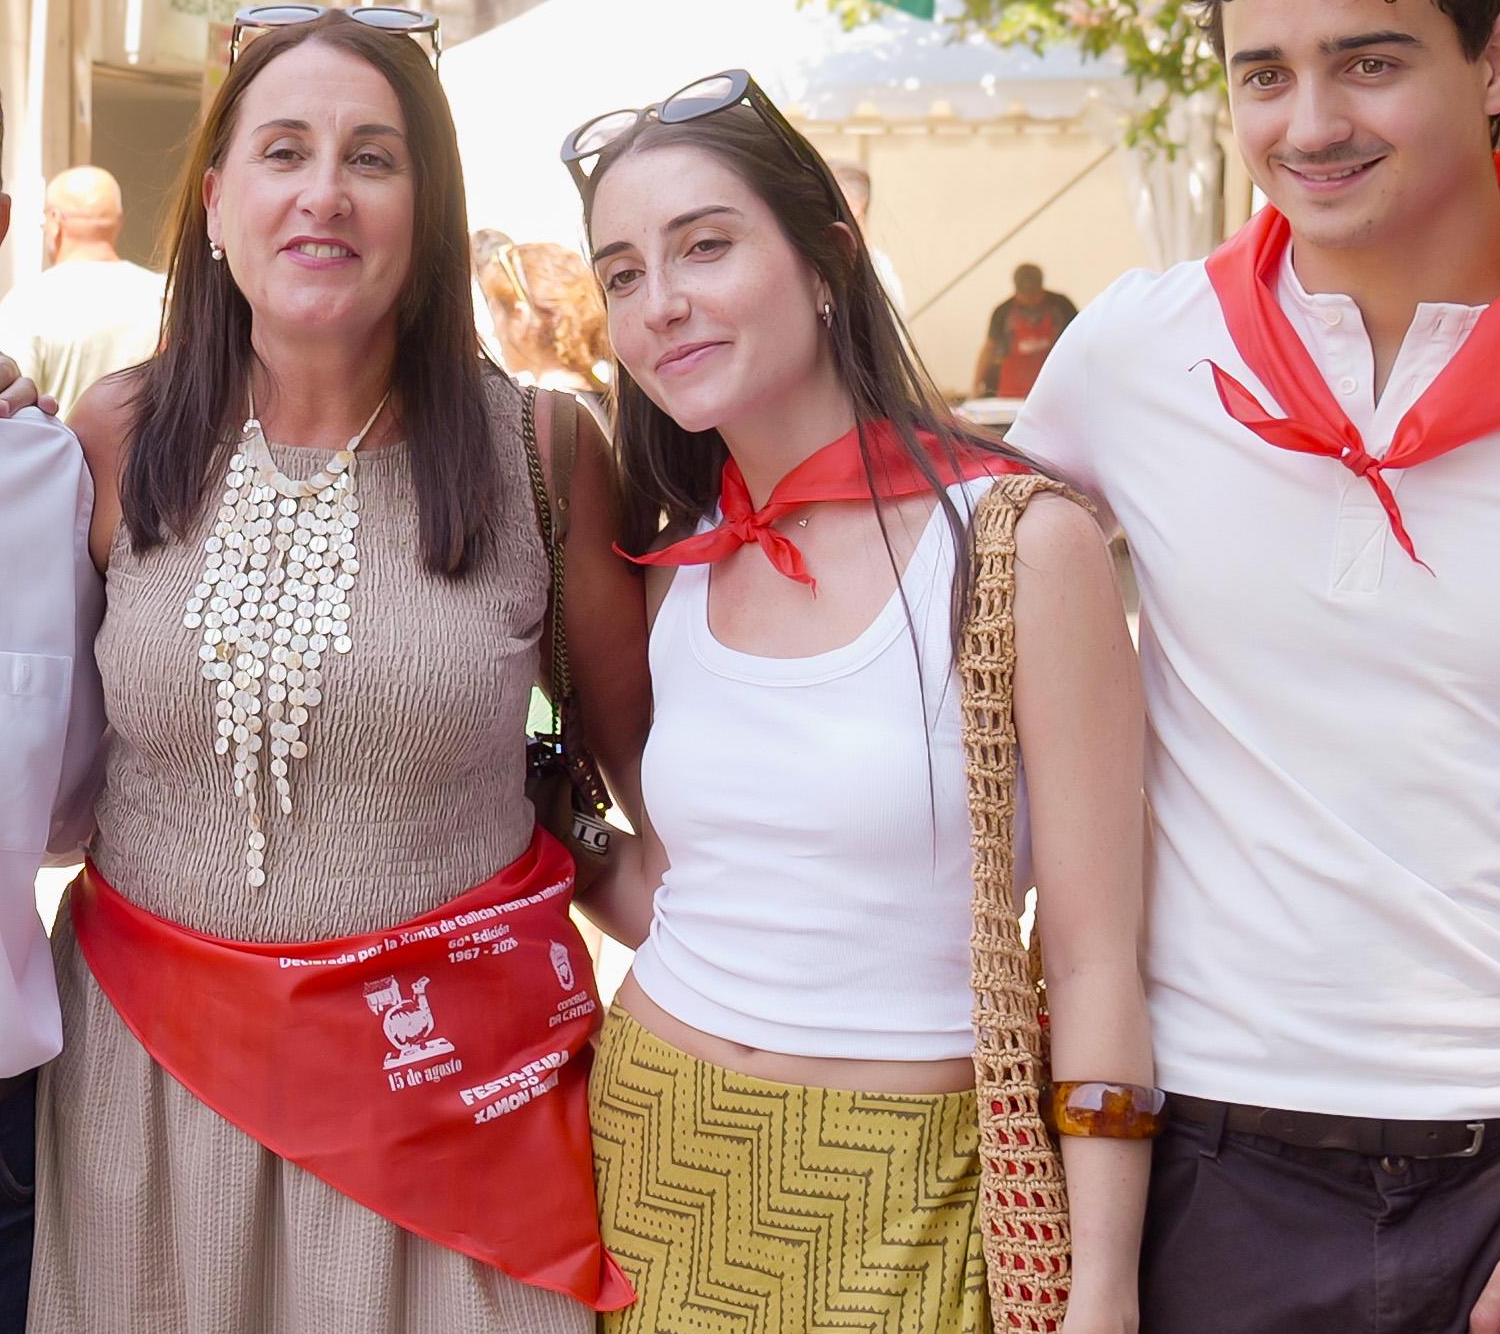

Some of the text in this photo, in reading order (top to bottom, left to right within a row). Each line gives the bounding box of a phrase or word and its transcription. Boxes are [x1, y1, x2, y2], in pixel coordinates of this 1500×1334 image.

[357, 945, 383, 963] por
[383, 938, 398, 952] la
[400, 924, 440, 946] Xunta
[440, 918, 457, 934] de
[455, 904, 497, 927] Galicia
[471, 923, 510, 945] Edición
[448, 947, 480, 963] 1967
[388, 1058, 463, 1092] 15 de agosto
[519, 1075, 540, 1090] DO
